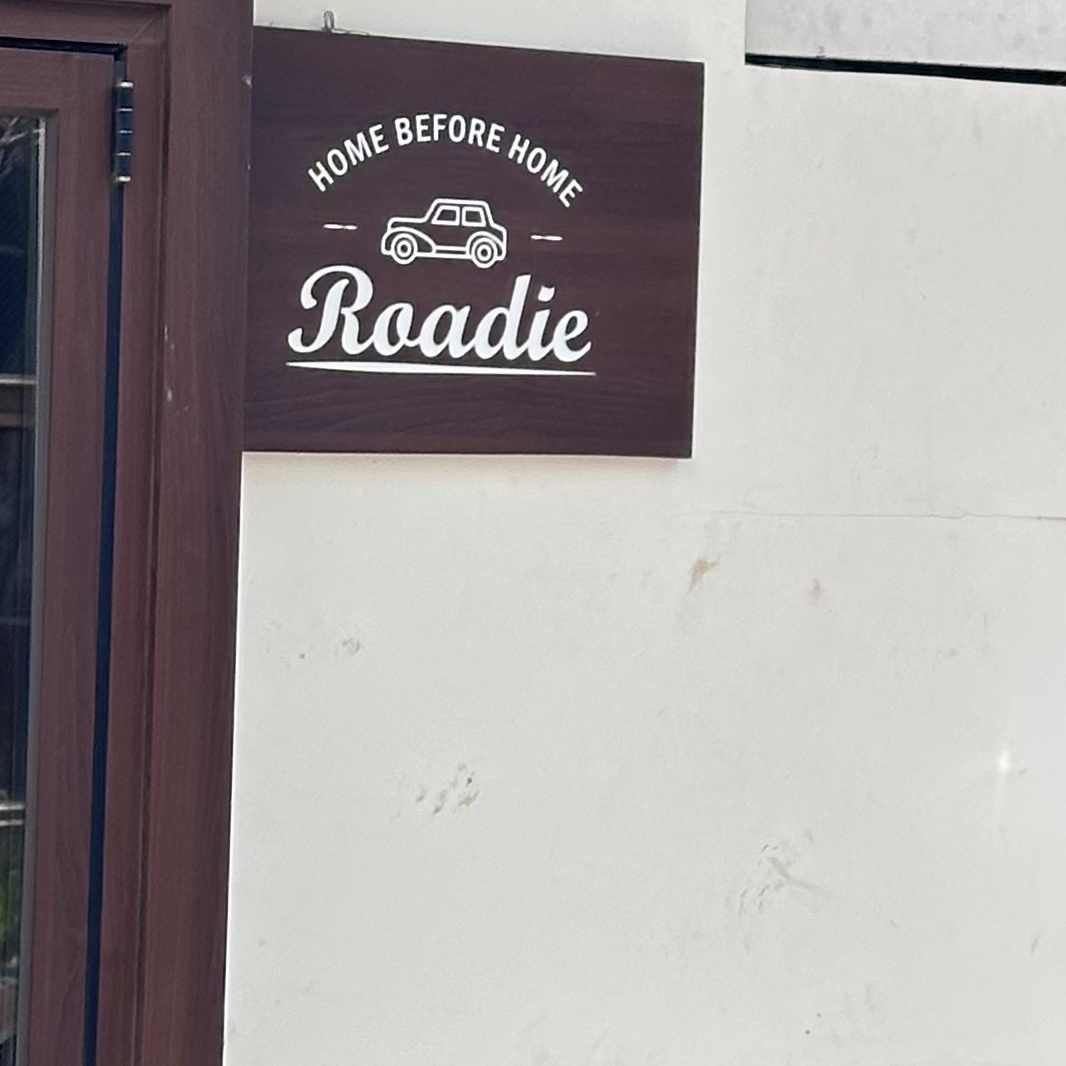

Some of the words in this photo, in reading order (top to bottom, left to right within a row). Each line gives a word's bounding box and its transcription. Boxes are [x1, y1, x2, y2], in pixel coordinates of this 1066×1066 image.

[308, 124, 389, 191] HOME
[394, 114, 505, 152] BEFORE
[508, 134, 583, 208] HOME
[287, 265, 592, 363] Roadie
